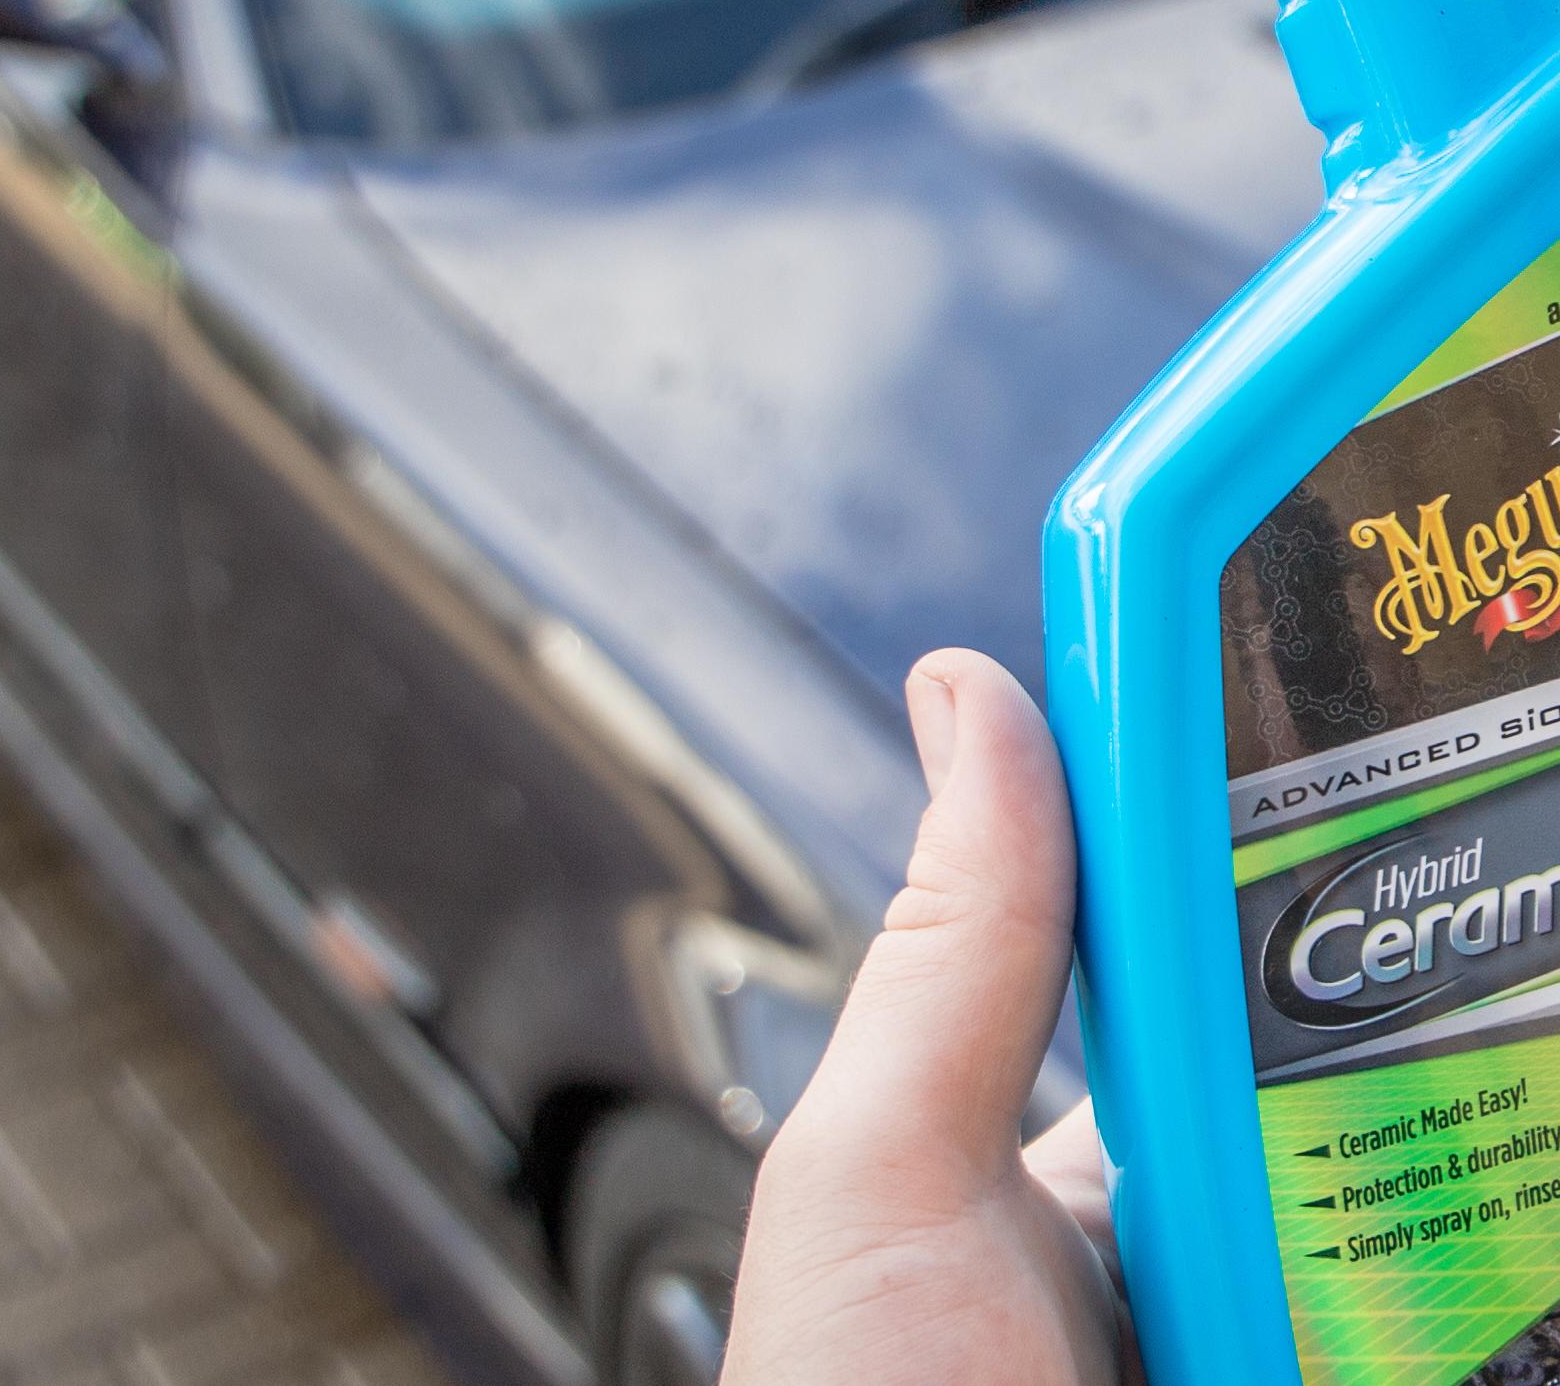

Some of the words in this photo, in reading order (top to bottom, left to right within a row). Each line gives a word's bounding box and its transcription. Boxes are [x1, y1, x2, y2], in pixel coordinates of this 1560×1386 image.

[1252, 732, 1481, 818] ADVANCED
[1373, 837, 1483, 912] Hybrid
[1340, 1116, 1417, 1159] Ceramic
[1421, 1098, 1474, 1135] Made
[1478, 1077, 1528, 1117] Easy!
[1343, 1164, 1444, 1213] Protection
[1448, 1153, 1463, 1180] &
[1348, 1222, 1414, 1262] Simply
[1421, 1207, 1472, 1243] spray
[1478, 1196, 1511, 1221] on,
